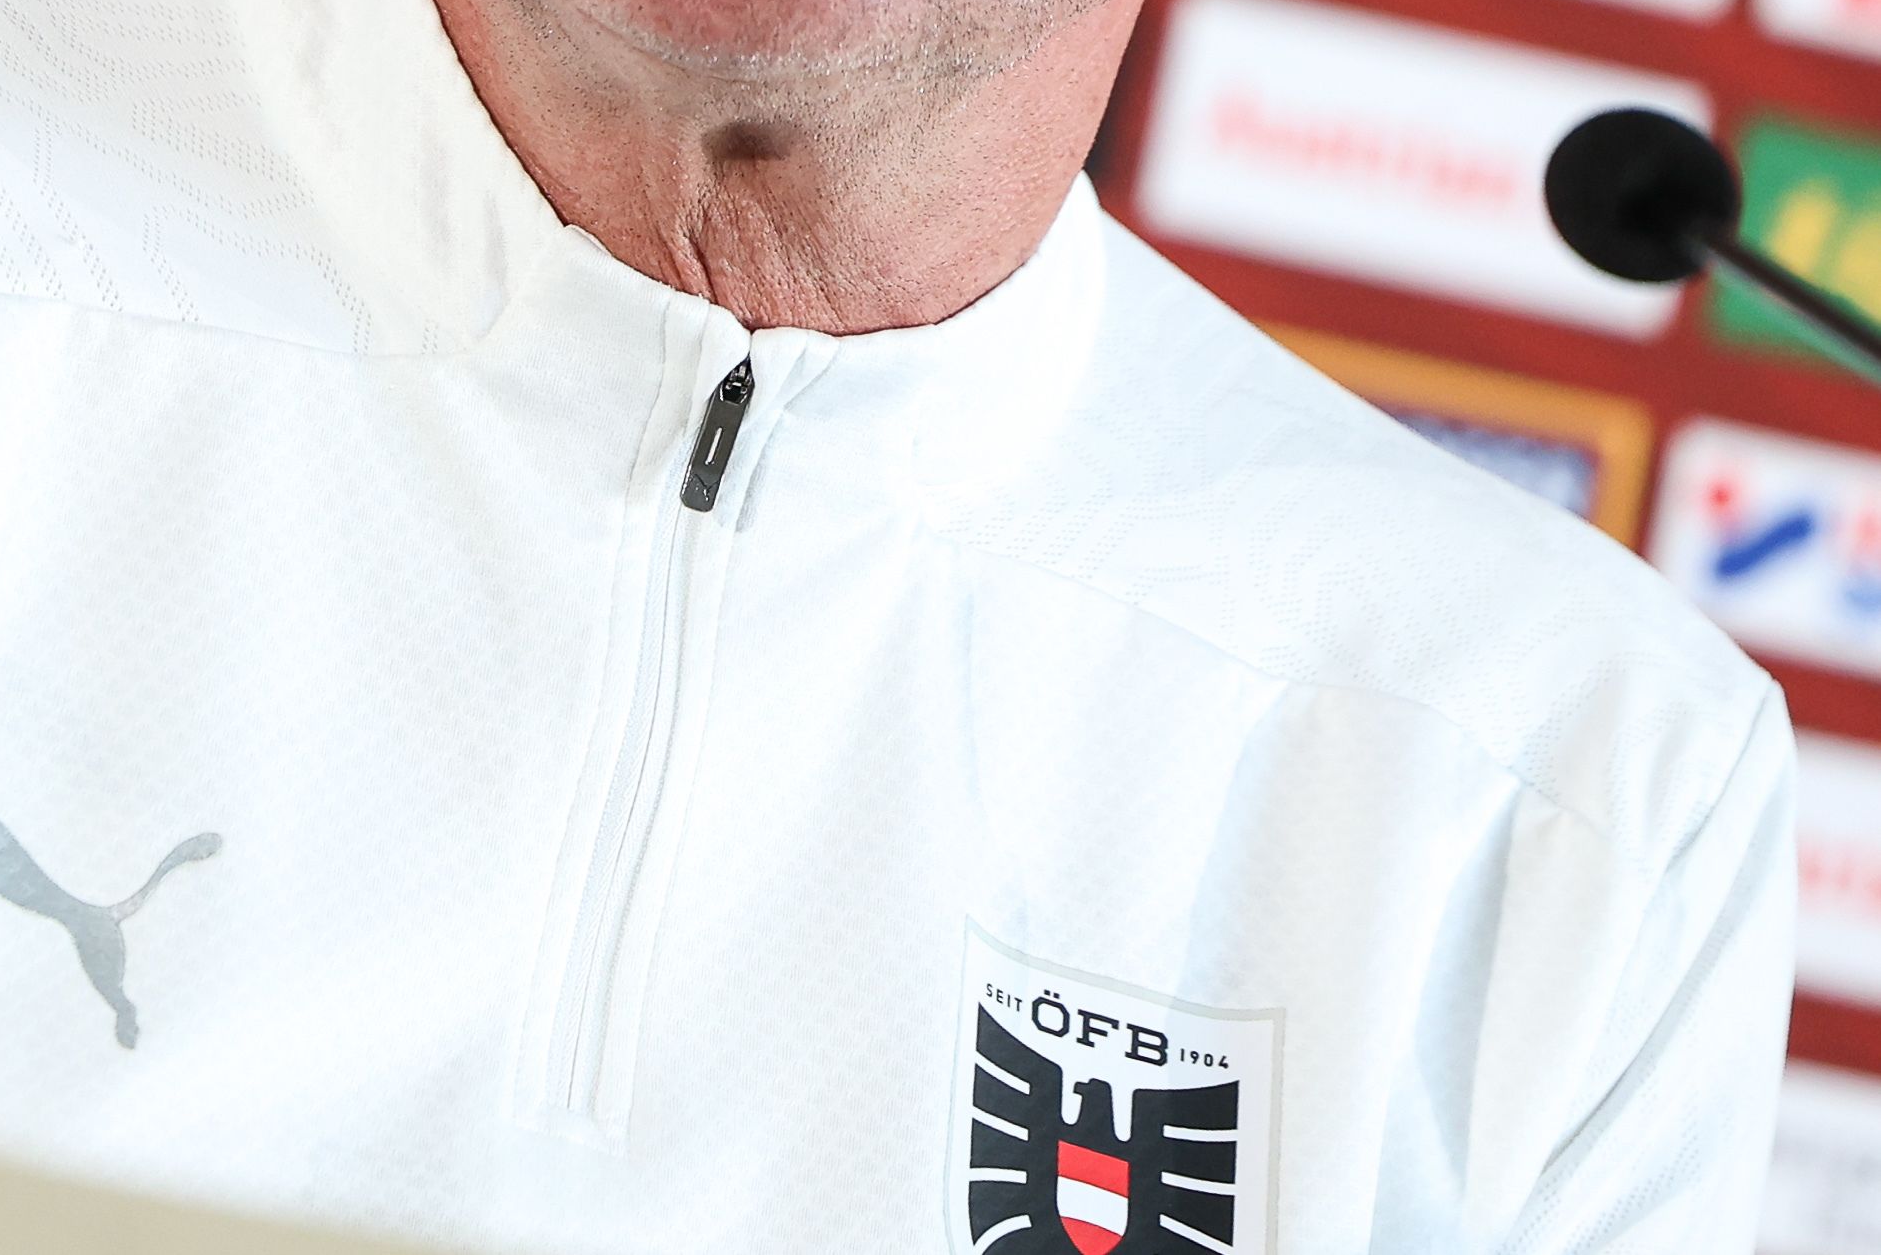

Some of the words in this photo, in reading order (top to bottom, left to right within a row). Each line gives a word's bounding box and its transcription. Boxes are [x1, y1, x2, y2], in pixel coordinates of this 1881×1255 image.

[985, 982, 1023, 1012] SEIT
[1030, 988, 1170, 1067] ÖFB
[1179, 1047, 1230, 1069] 1904
